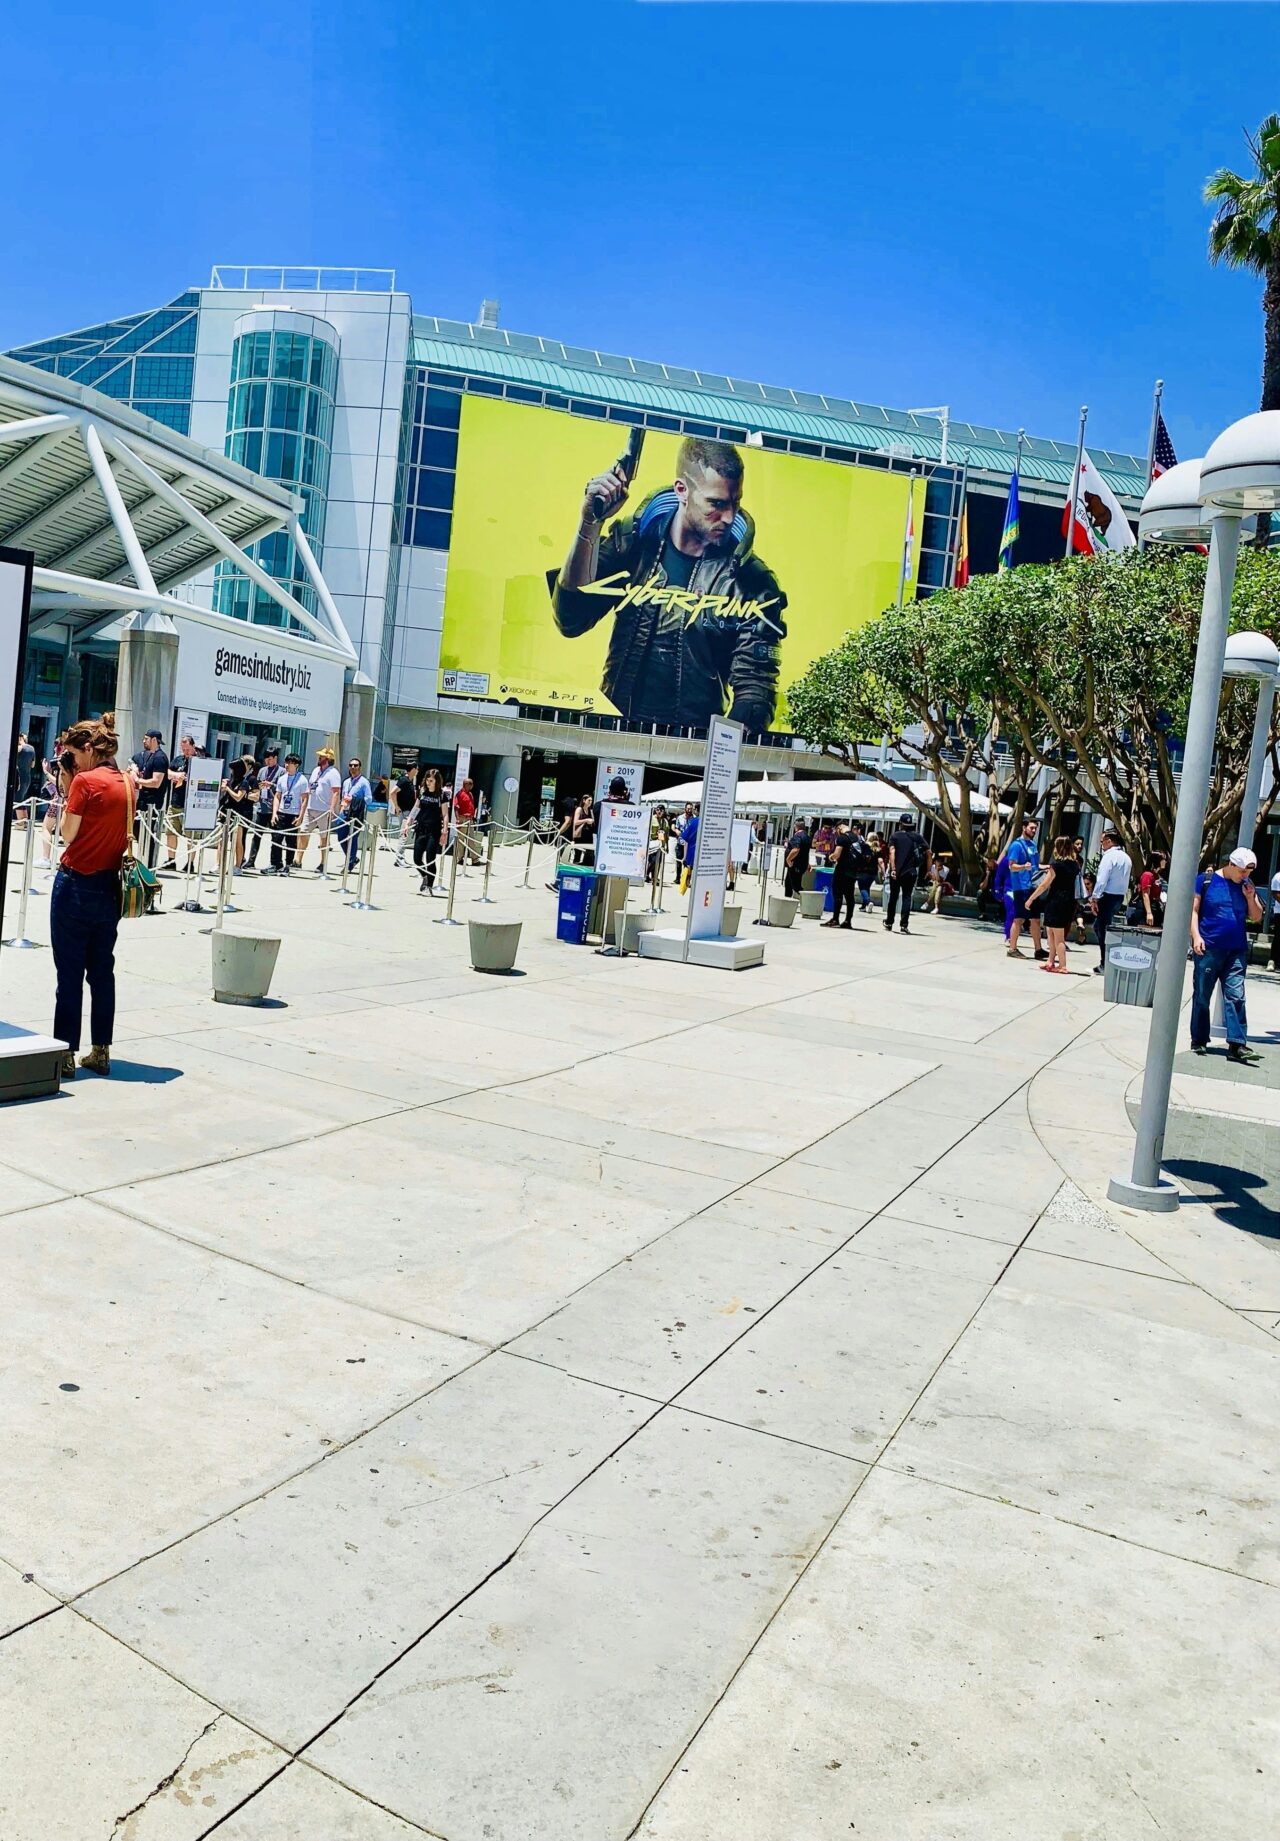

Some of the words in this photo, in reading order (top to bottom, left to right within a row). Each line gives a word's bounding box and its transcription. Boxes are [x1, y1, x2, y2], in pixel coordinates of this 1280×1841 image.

[703, 618, 757, 632] 2077
[215, 647, 312, 692] gamesindustry.biz
[445, 676, 456, 687] RP
[217, 691, 237, 704] Connect
[258, 699, 272, 711] global
[273, 703, 288, 714] games
[288, 705, 307, 717] business
[584, 697, 594, 705] PC
[617, 767, 635, 776] 2019
[622, 810, 642, 819] 2019
[581, 889, 592, 941] RECYCLE
